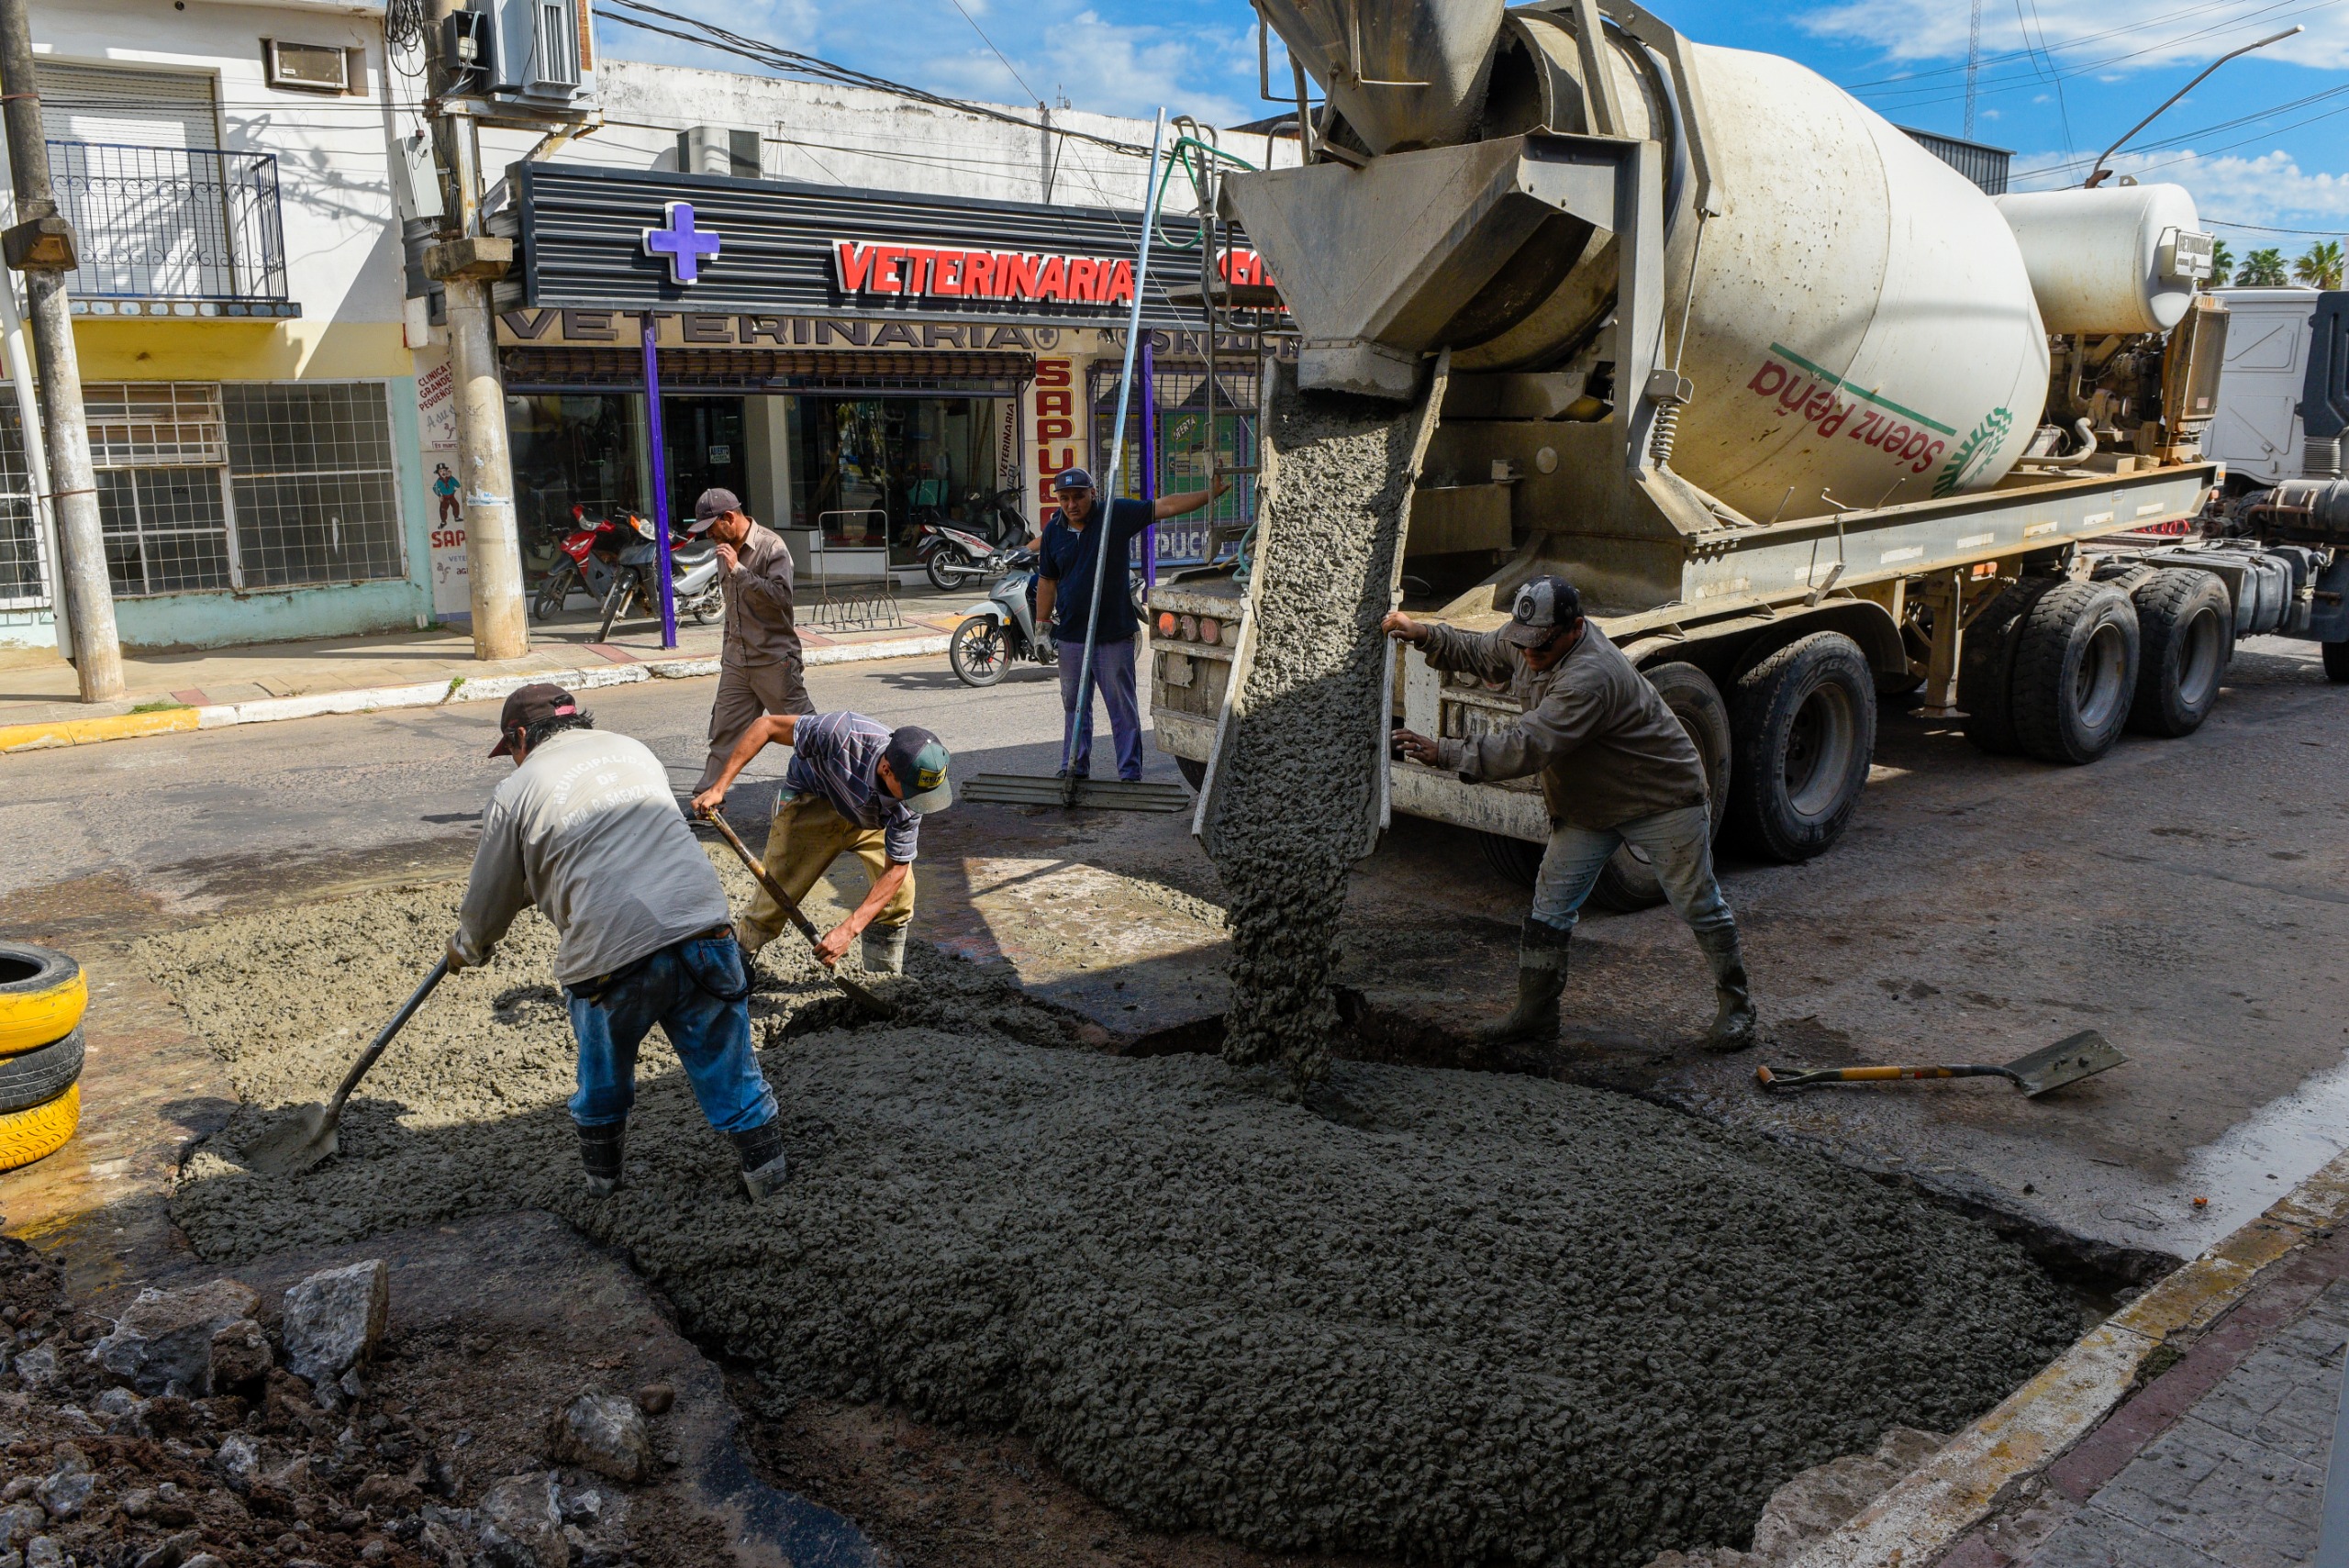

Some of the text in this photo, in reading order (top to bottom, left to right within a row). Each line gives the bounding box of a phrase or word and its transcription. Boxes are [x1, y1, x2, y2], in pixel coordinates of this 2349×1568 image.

[836, 240, 1135, 305] VETERINARIA
[417, 365, 447, 387] CLINICA
[1747, 360, 1945, 473] Sáenz Peña
[1000, 404, 1015, 477] VETERINARIA
[596, 772, 618, 786] DE
[606, 784, 644, 806] SAENZ
